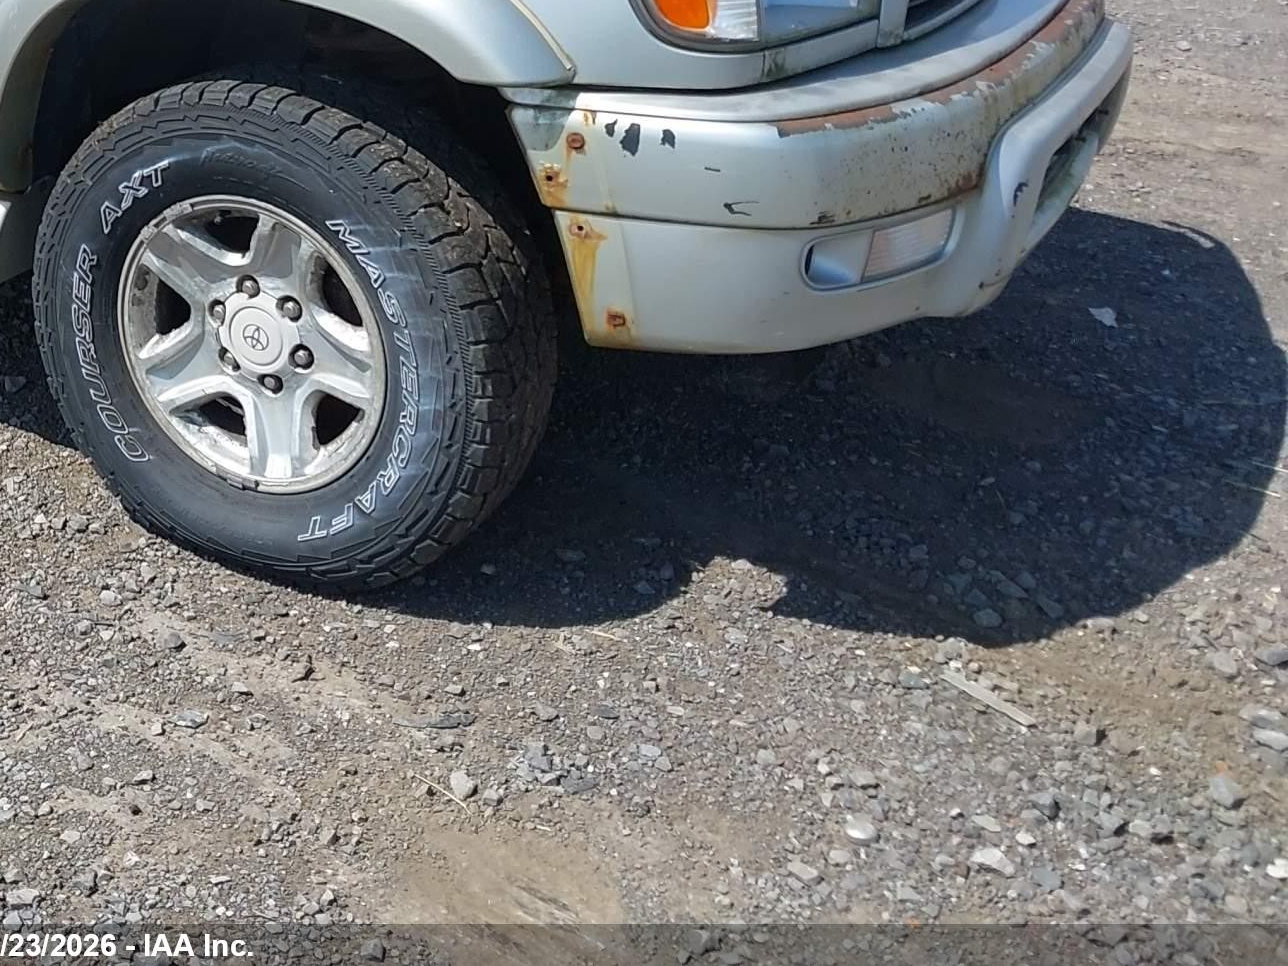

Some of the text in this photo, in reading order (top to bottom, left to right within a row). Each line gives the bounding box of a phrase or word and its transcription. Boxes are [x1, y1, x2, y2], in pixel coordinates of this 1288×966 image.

[74, 161, 170, 463] COURSER AXT
[297, 218, 421, 542] MASTERCRAFT
